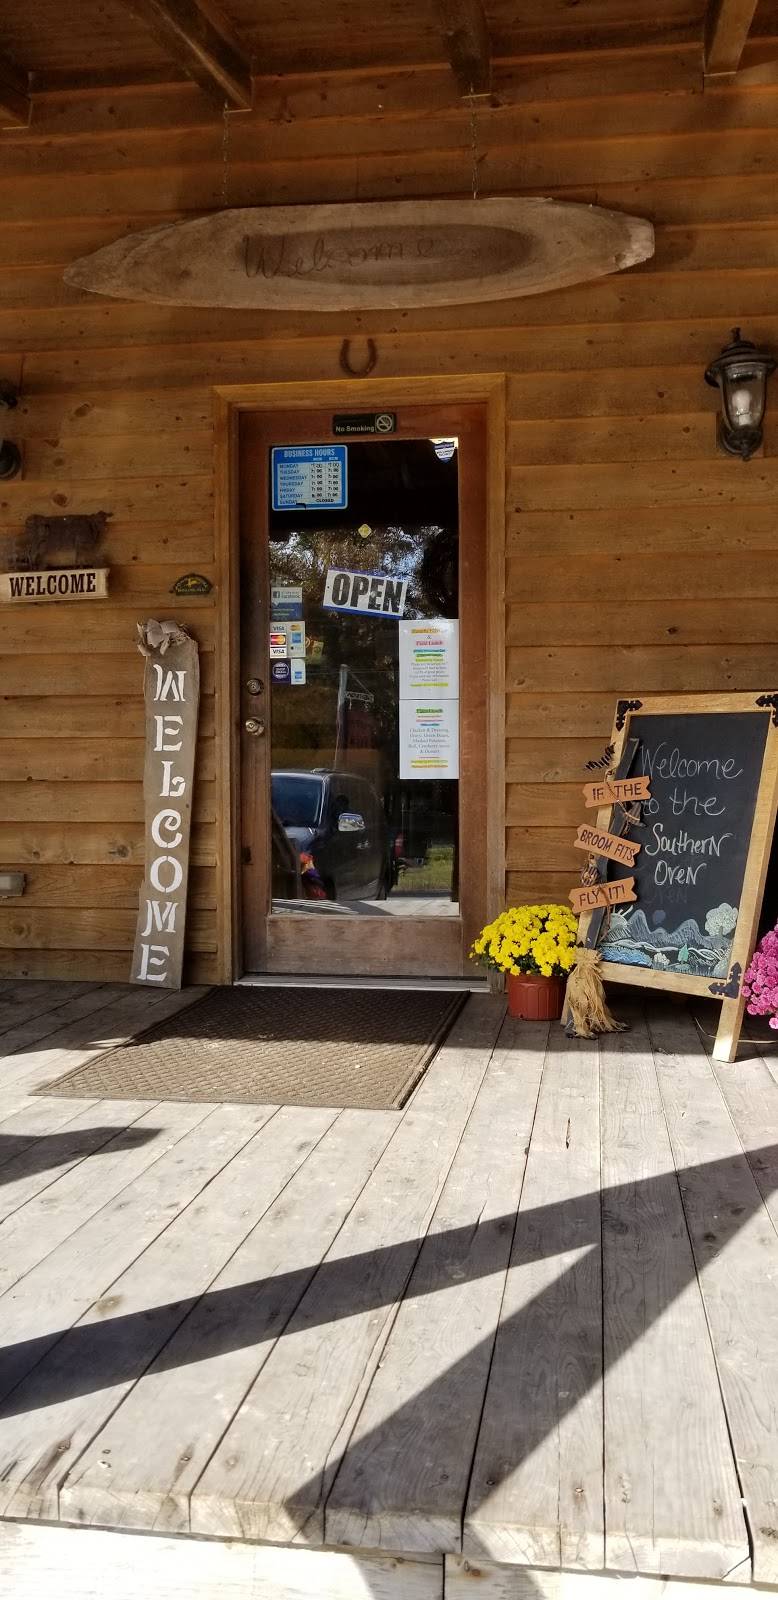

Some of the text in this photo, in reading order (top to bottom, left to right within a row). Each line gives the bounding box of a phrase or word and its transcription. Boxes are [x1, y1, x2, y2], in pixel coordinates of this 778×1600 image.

[346, 424, 375, 433] Smoking
[284, 448, 335, 458] BUSINESS HOURS
[9, 572, 97, 598] WELCOME
[332, 573, 404, 614] OPEN
[641, 742, 743, 781] Welcome
[592, 782, 642, 800] IF THE
[640, 787, 727, 816] to the
[136, 664, 187, 983] WELCOME
[580, 829, 612, 853] BROOM
[645, 823, 733, 857] Southern
[654, 860, 708, 886] Oven
[579, 884, 626, 906] FLY IT!
